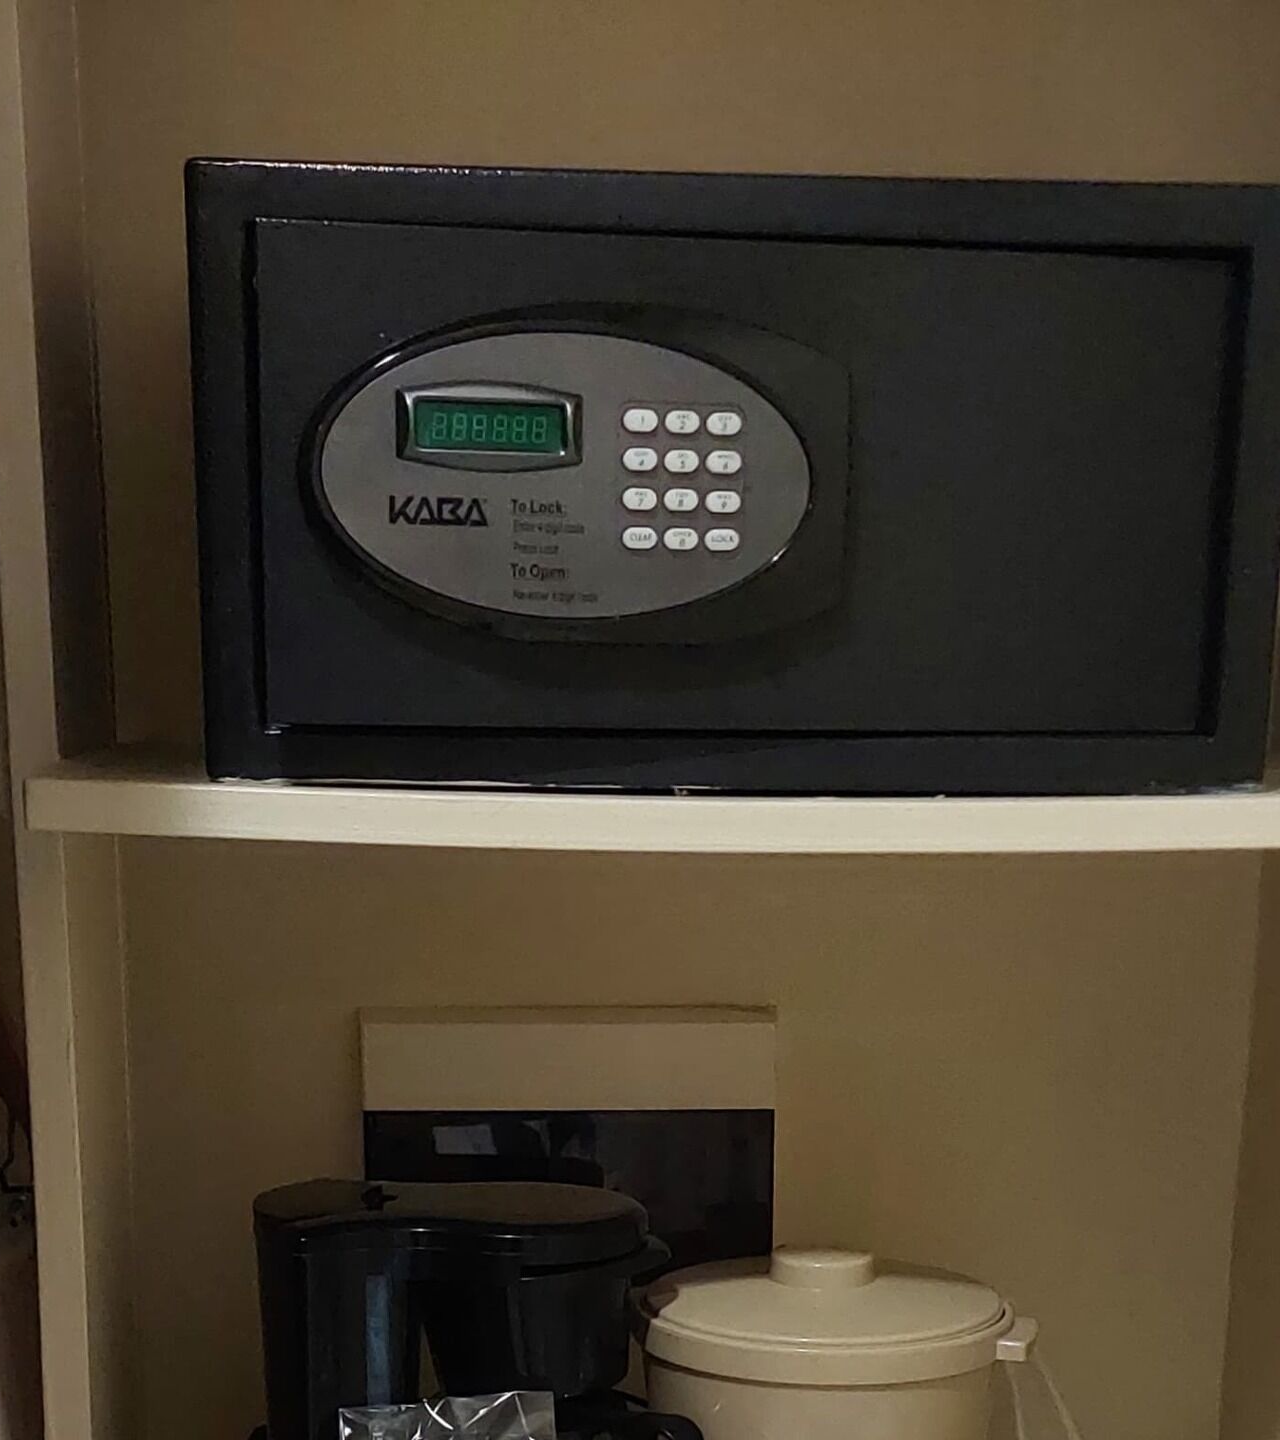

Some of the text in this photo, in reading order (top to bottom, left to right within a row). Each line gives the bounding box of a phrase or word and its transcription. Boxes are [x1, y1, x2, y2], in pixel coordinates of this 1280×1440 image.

[389, 495, 488, 527] KABA
[510, 499, 526, 514] To
[510, 562, 526, 577] To
